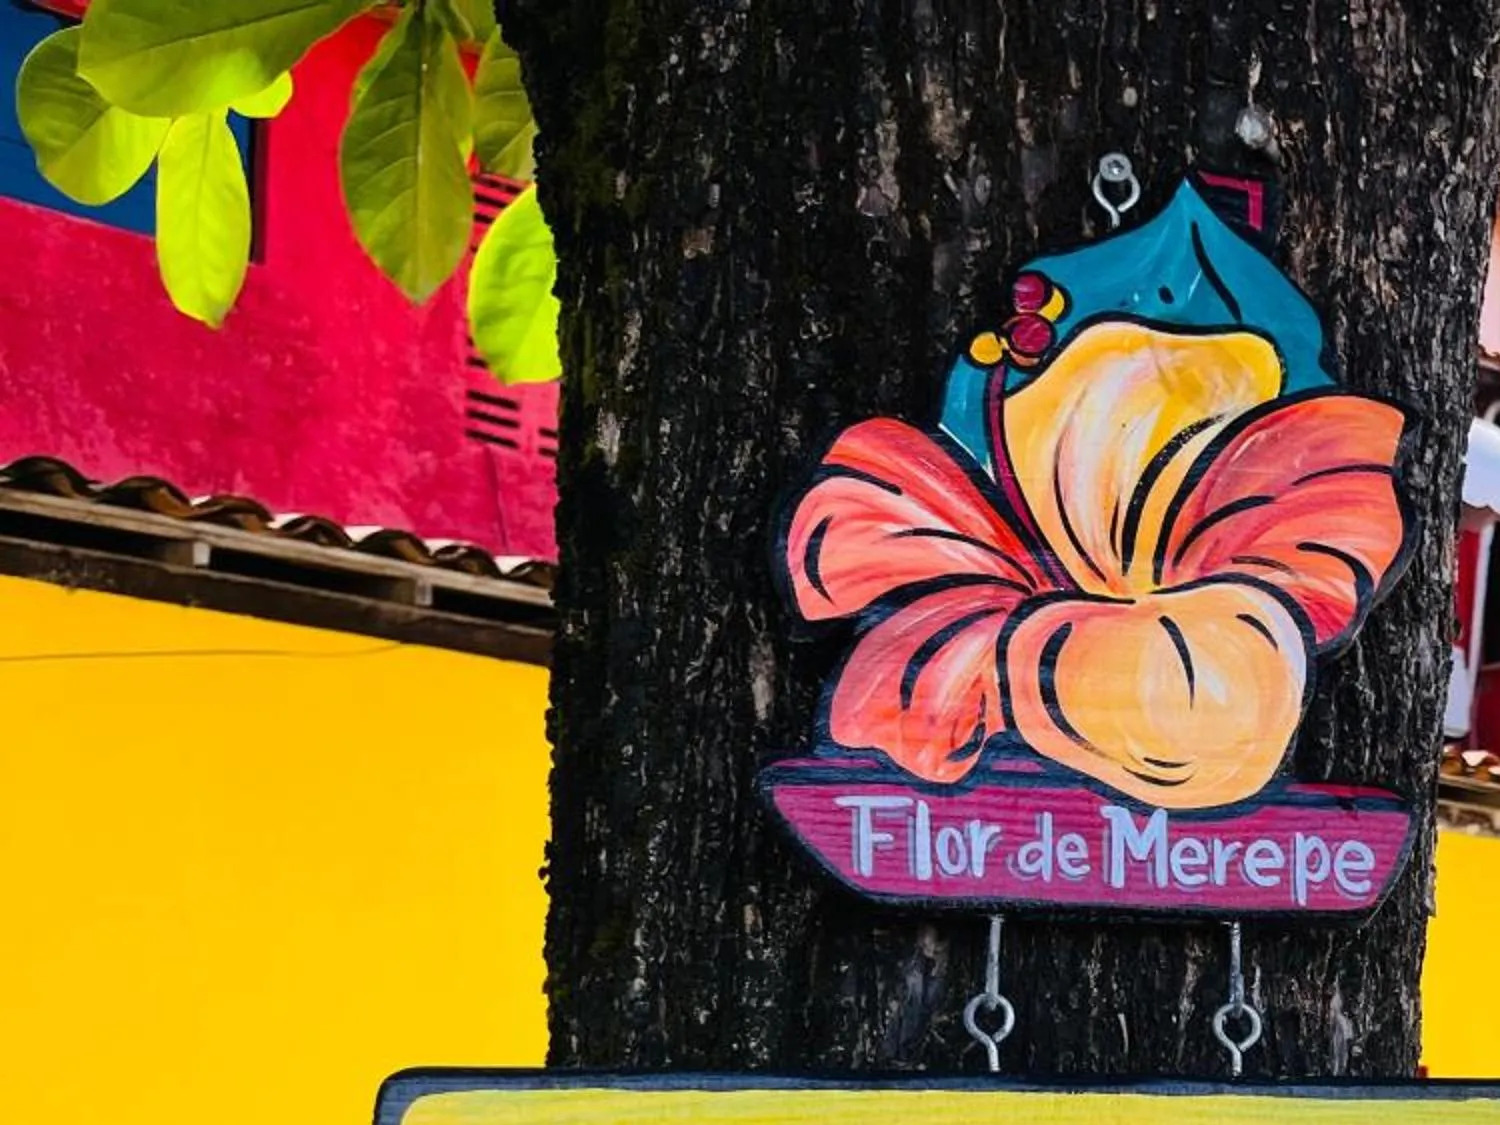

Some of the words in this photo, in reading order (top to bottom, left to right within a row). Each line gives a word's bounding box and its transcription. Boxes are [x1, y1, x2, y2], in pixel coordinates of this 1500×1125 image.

[836, 796, 1000, 879] Flor
[1008, 812, 1090, 879] de
[1102, 805, 1376, 905] Merepe
